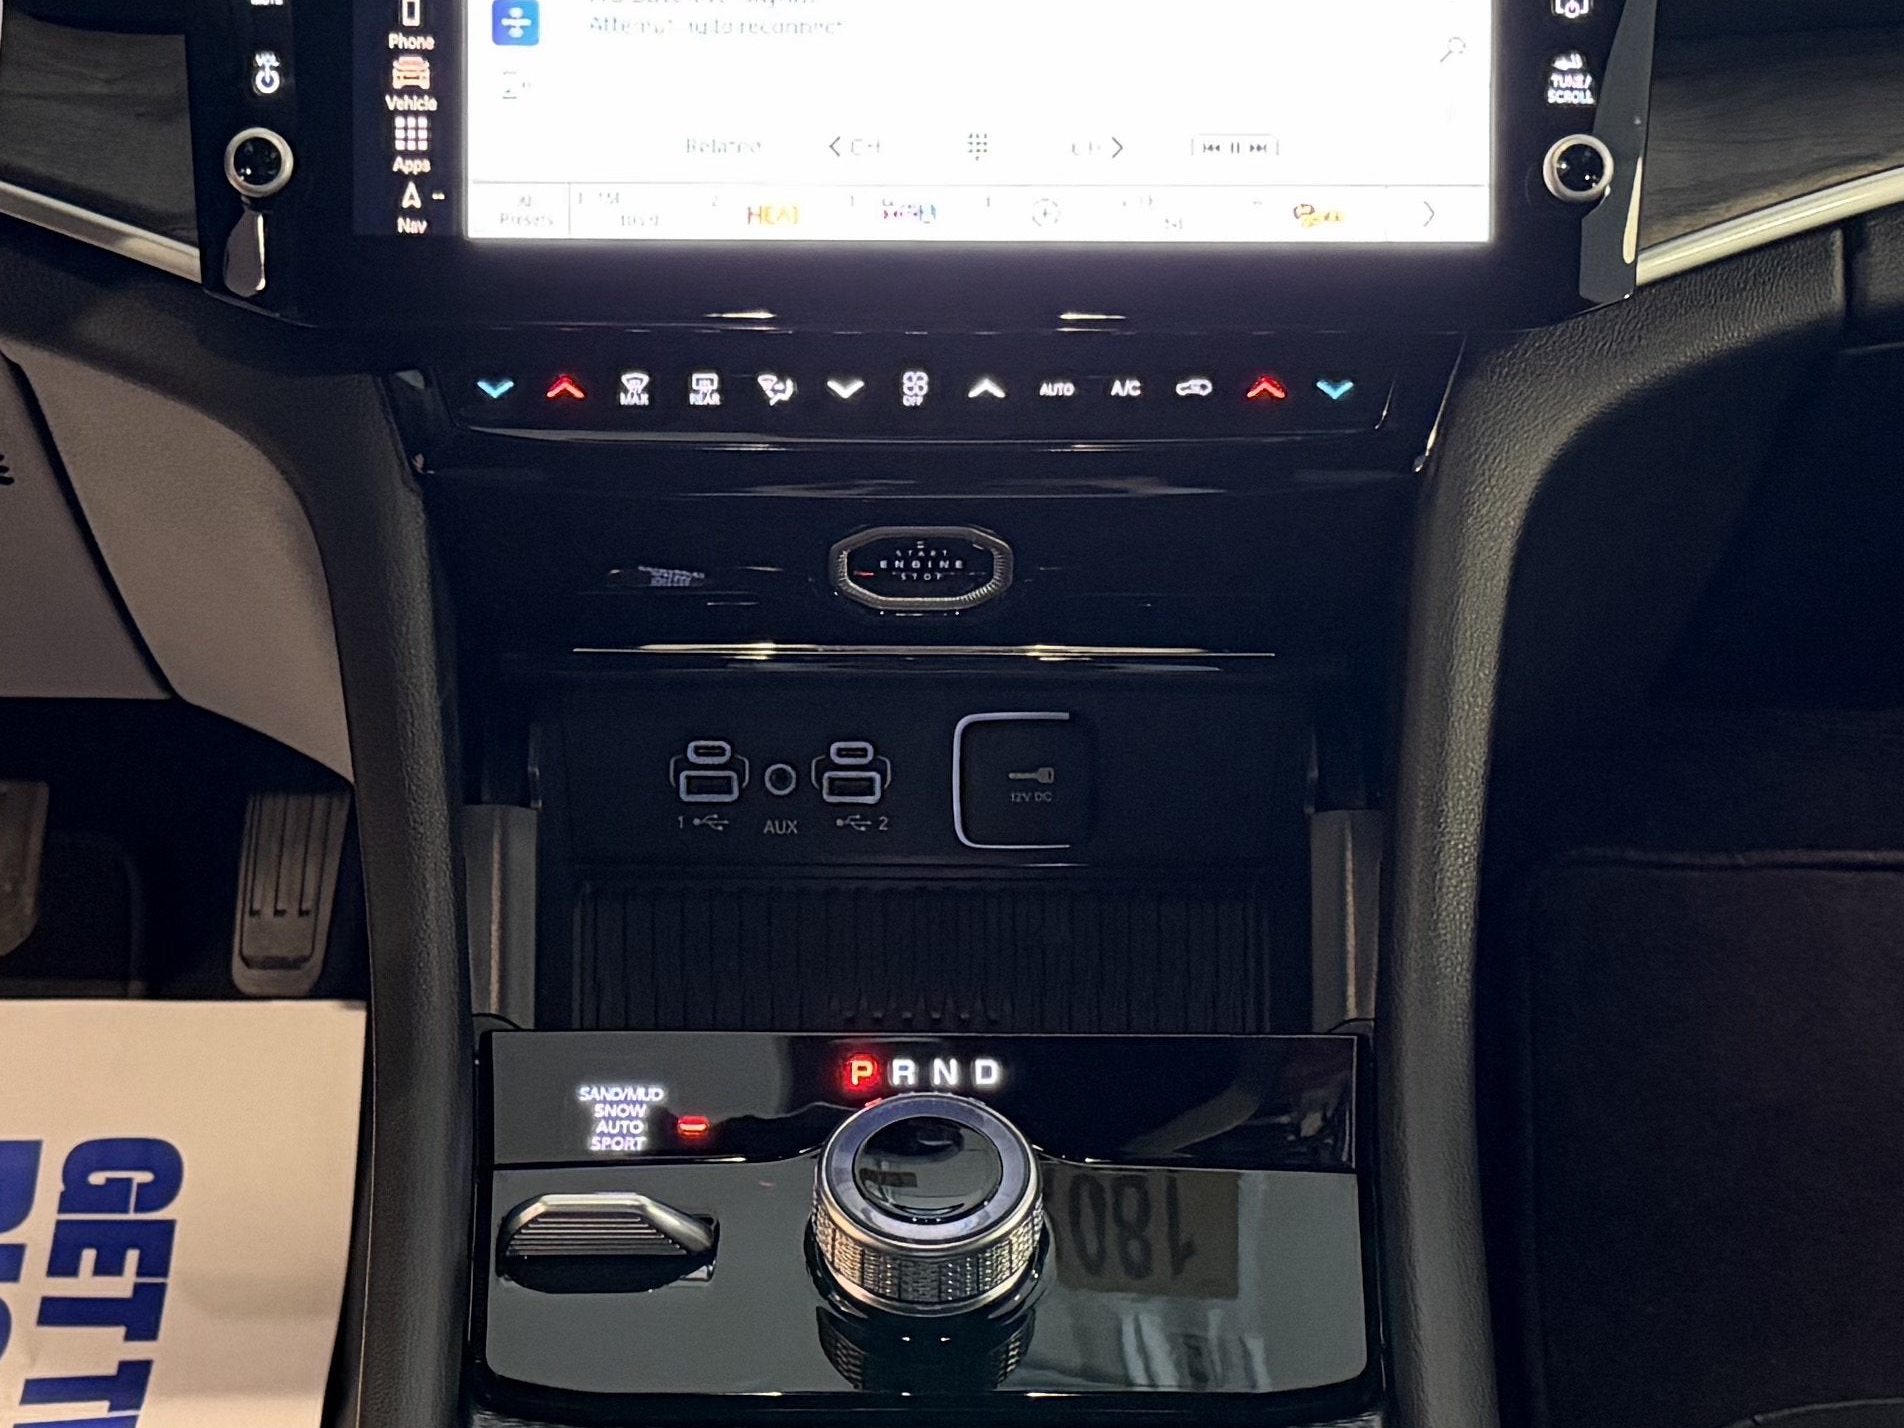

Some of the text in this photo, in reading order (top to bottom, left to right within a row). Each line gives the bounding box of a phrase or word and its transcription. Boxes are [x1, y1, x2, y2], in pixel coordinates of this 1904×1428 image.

[387, 32, 436, 51] Phone
[384, 93, 439, 112] Vehicle
[1546, 89, 1596, 105] SCROLL
[391, 156, 432, 176] Apps
[396, 217, 428, 237] Nav
[1038, 379, 1076, 397] AUTO
[1110, 378, 1142, 397] A/C
[879, 559, 964, 569] ENGINE
[763, 819, 798, 835] AUX
[878, 815, 889, 831] 2
[850, 1059, 998, 1085] P R N D
[578, 1085, 665, 1102] SAND/MUD
[593, 1103, 647, 1118] SNOW
[595, 1119, 645, 1134] AUTO
[590, 1135, 647, 1152] SPORT
[36, 1135, 185, 1342] GET
